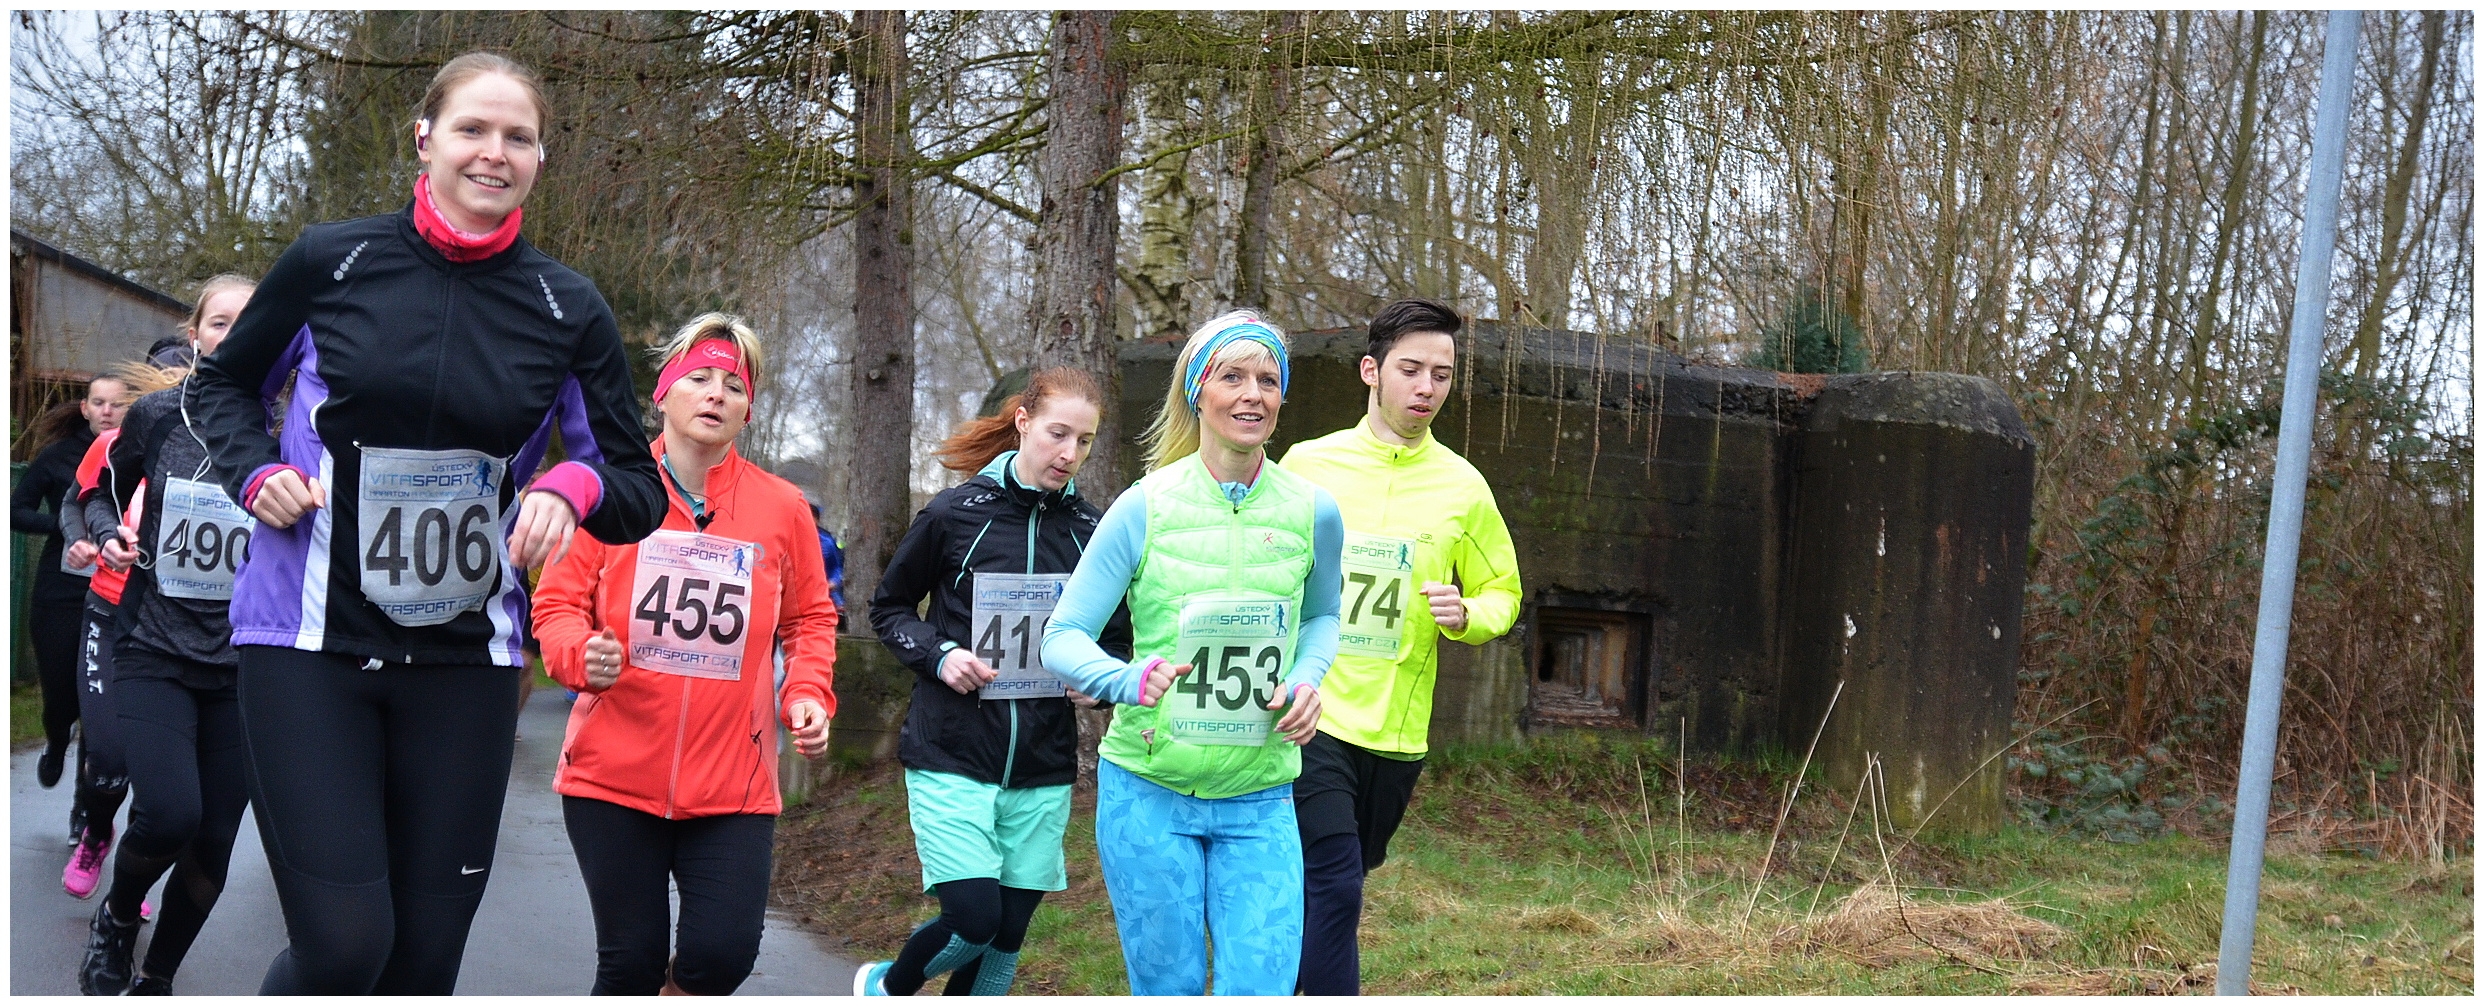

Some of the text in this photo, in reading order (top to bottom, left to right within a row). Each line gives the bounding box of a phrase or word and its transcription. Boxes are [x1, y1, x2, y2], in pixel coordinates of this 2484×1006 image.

[369, 472, 473, 488] VITASPORT
[162, 518, 252, 575] 490
[365, 503, 492, 587] 406
[646, 540, 729, 564] VITASPORT
[634, 574, 746, 646] 455
[980, 590, 1052, 601] VITASPORT
[1188, 614, 1271, 626] VITASPORT
[1340, 571, 1402, 630] 74
[975, 614, 1051, 670] 41
[1176, 645, 1282, 712] 453
